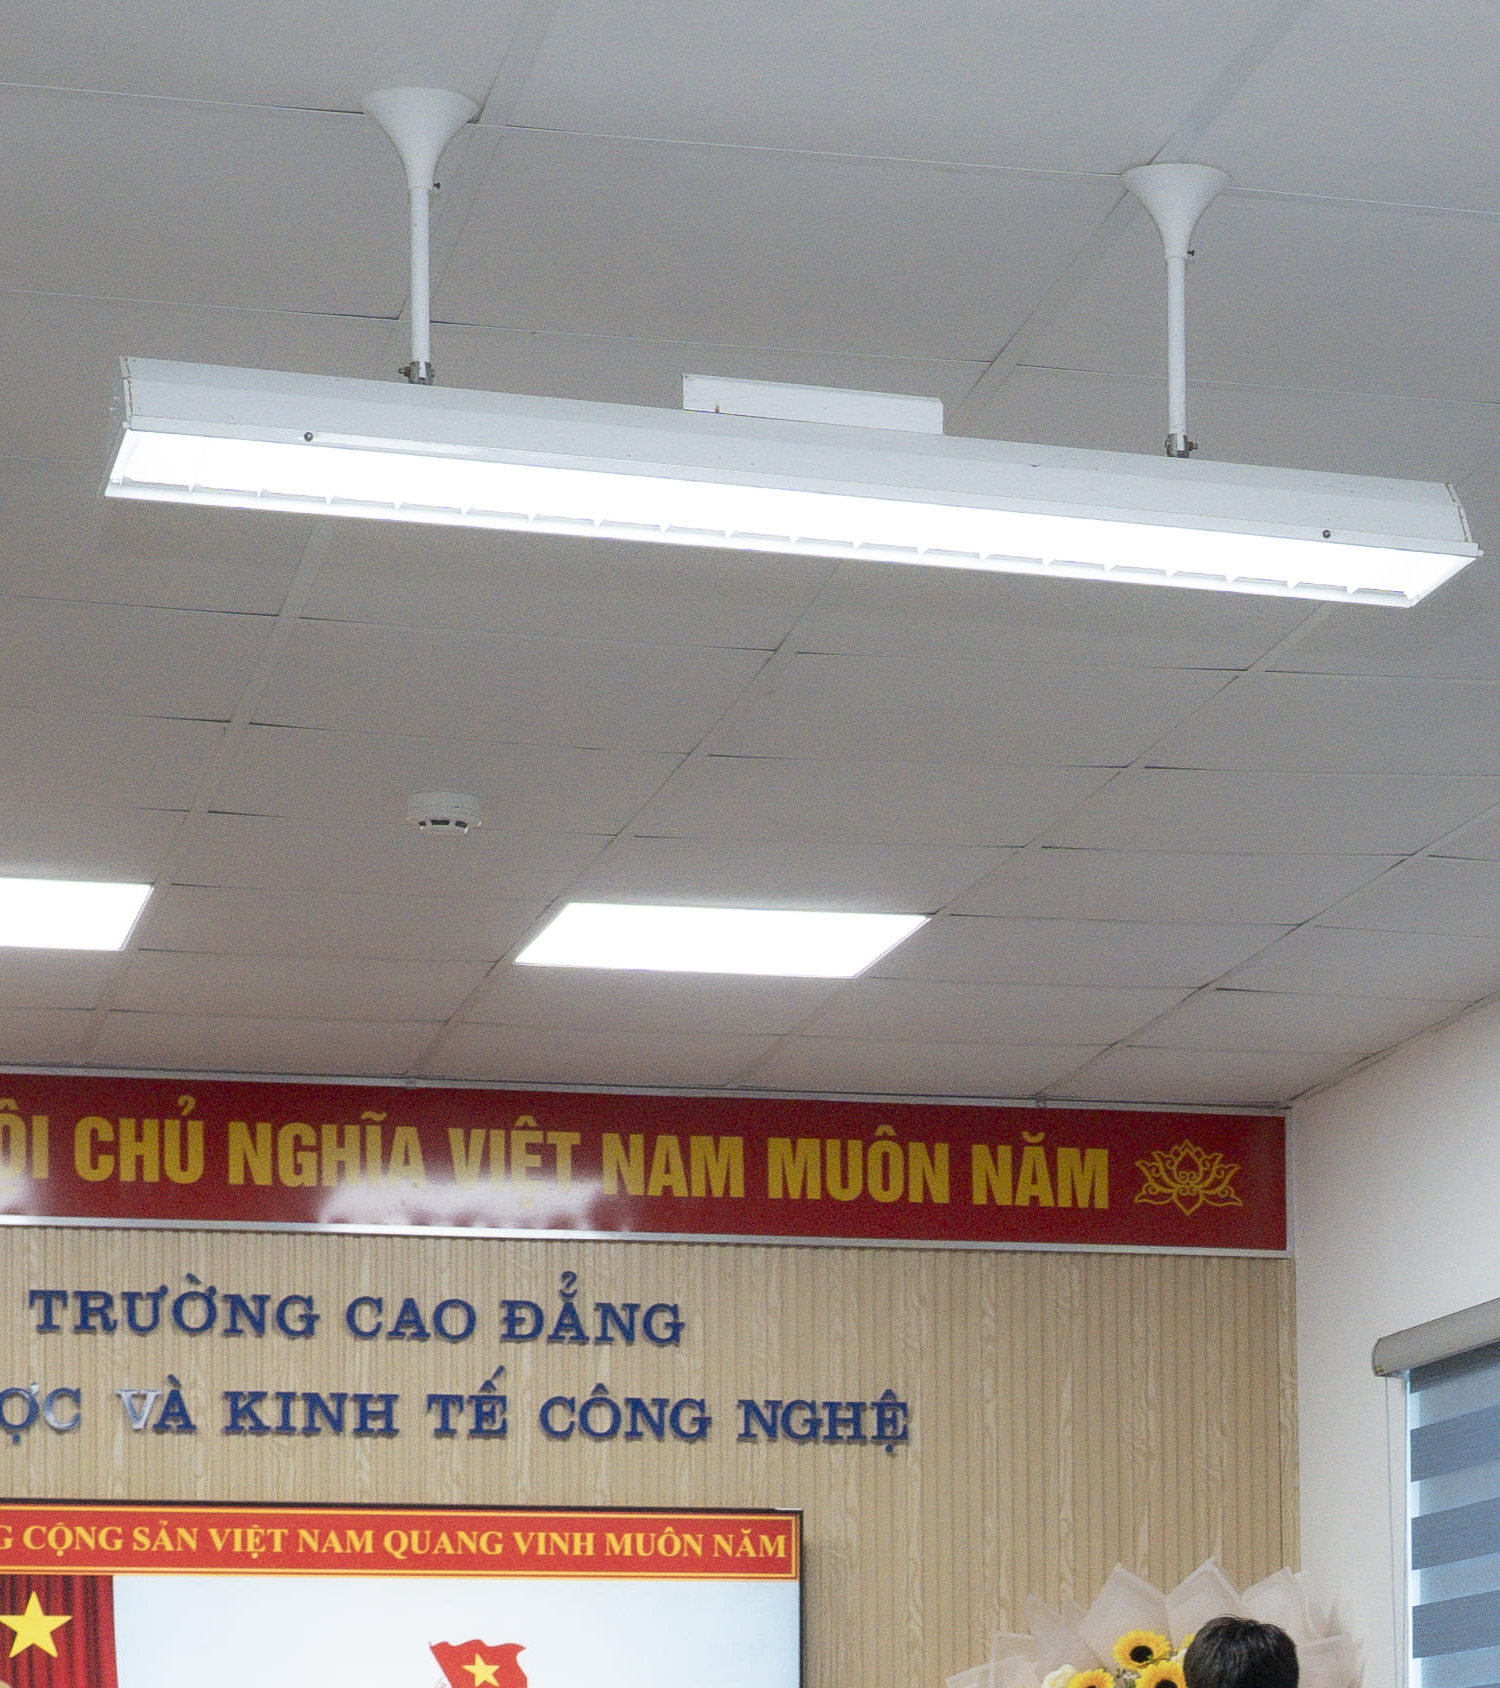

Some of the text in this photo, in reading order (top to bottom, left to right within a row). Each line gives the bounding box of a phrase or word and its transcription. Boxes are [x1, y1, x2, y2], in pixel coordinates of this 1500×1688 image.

[73, 1095, 205, 1184] CHỦ
[227, 1110, 428, 1188] NGHĨA
[448, 1114, 582, 1208] VIỆT
[600, 1132, 745, 1198] NAM
[767, 1124, 950, 1204] MUÔN
[971, 1131, 1110, 1209] NĂM
[29, 1270, 686, 1345] TRƯỜNG CAO ĐẲNG
[116, 1373, 197, 1434] VÀ
[222, 1390, 399, 1438] KINH
[427, 1364, 508, 1438] TẾ
[540, 1382, 712, 1441] CÔNG
[738, 1388, 910, 1454] NGHỆ
[22, 1522, 123, 1557] CỘNG
[132, 1519, 198, 1552] SẢN
[210, 1525, 288, 1559] VIỆT
[298, 1529, 374, 1554] NAM
[383, 1529, 504, 1560] QUANG
[512, 1532, 596, 1556] VINH
[604, 1526, 703, 1558] MUÔN
[712, 1529, 787, 1558] NĂM
